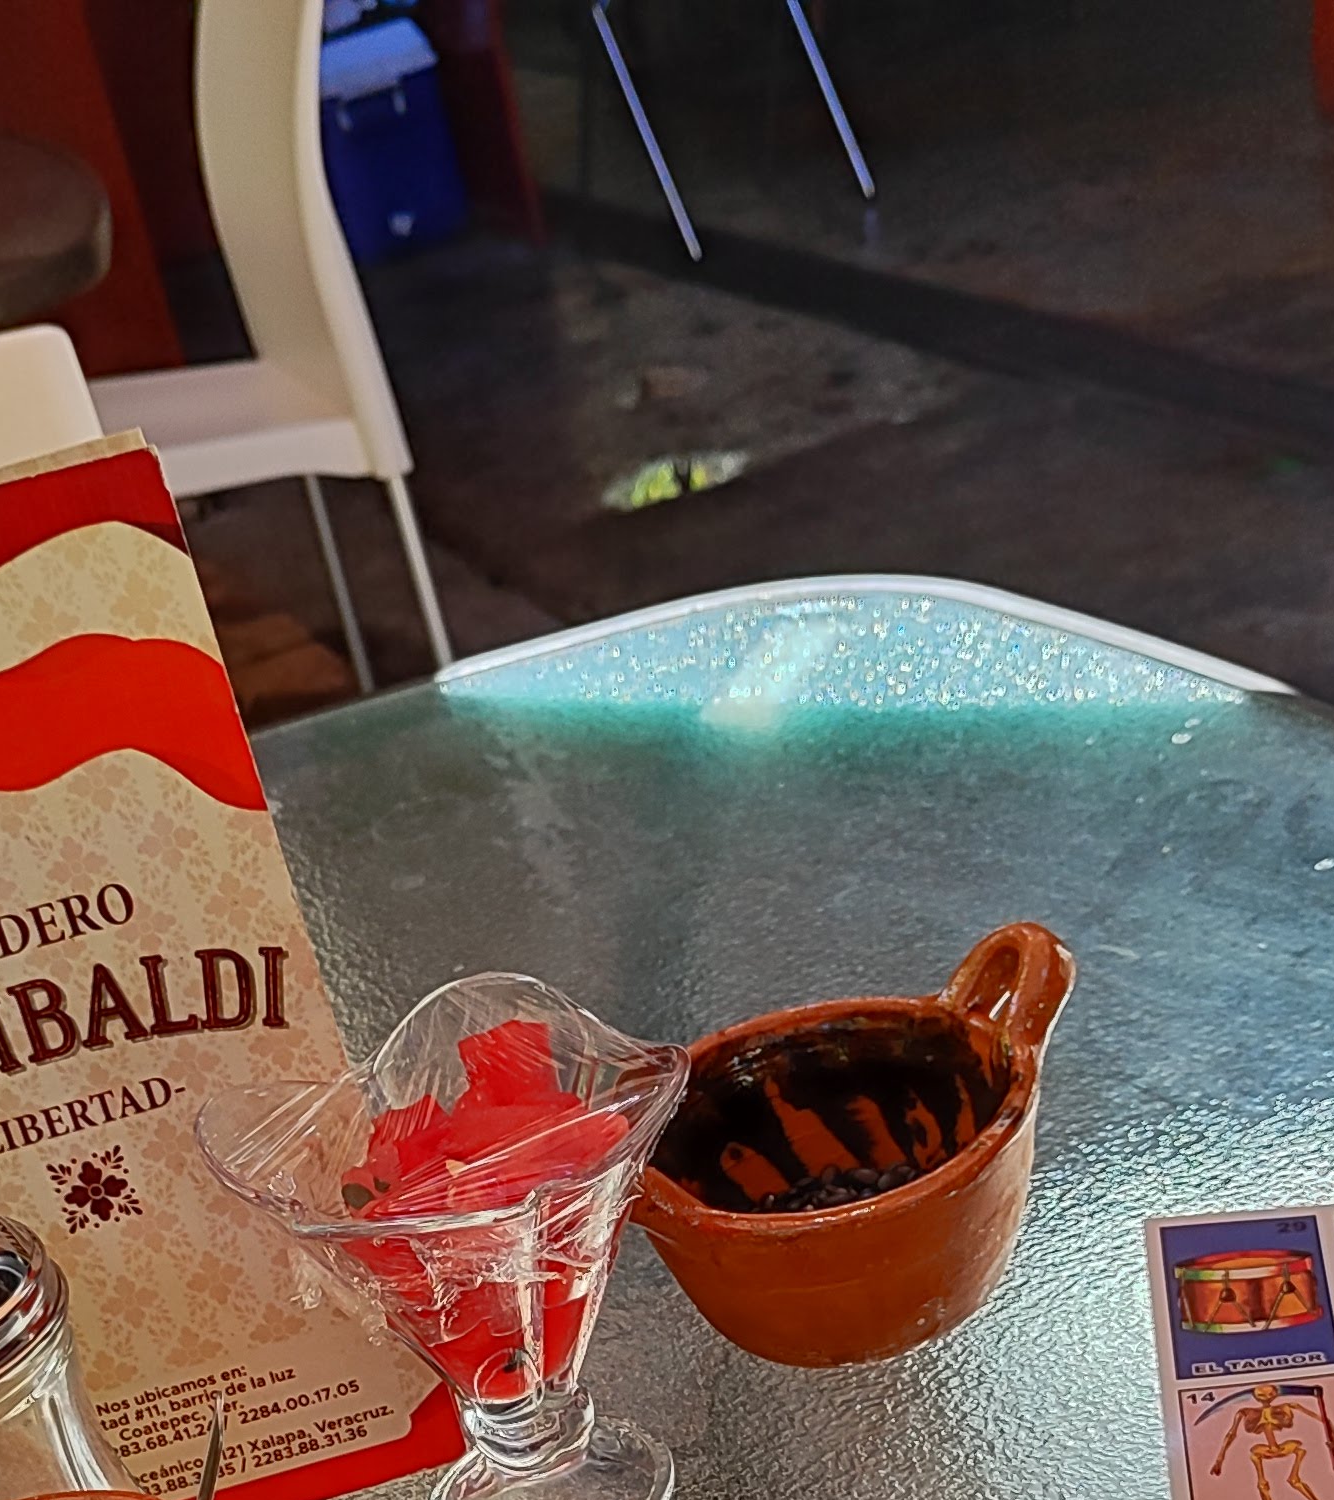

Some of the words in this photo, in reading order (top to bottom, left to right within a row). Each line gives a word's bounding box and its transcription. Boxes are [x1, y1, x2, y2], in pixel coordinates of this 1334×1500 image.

[1276, 1221, 1308, 1234] 29
[1194, 1363, 1222, 1374] EL
[1230, 1353, 1324, 1371] TAMBOR
[95, 1399, 131, 1417] Nos
[133, 1374, 217, 1406] ubicamos
[220, 1365, 248, 1382] en:
[134, 1403, 167, 1422] #11,
[168, 1388, 222, 1412] barrio
[224, 1382, 247, 1397] de
[250, 1376, 267, 1389] la
[268, 1368, 297, 1385] luz
[237, 1378, 361, 1424] 2284.00.17.05
[1186, 1391, 1216, 1405] 14
[119, 1410, 207, 1442] Coatepec,
[247, 1428, 312, 1454] Xalapa,
[313, 1405, 395, 1434] Veracruz.
[251, 1424, 368, 1468] 2283.88.31.36
